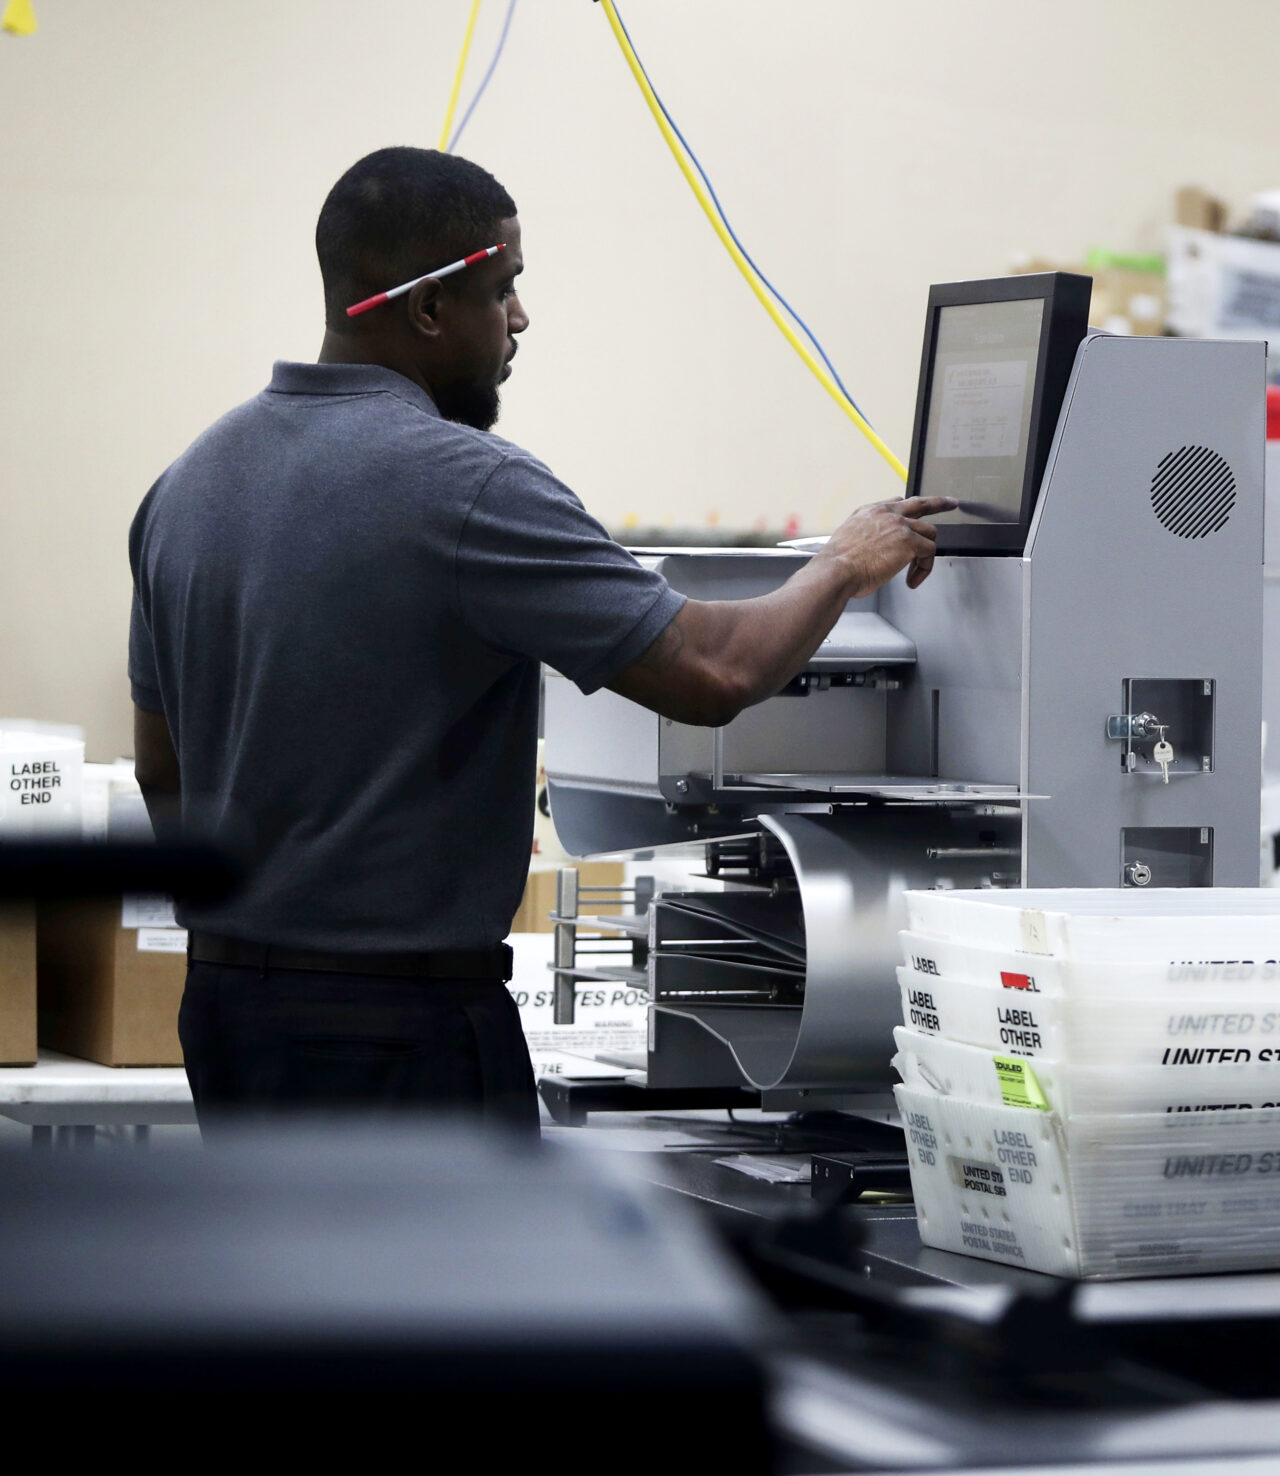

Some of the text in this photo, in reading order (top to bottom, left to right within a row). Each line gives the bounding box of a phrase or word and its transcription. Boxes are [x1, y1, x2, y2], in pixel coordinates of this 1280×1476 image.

[12, 761, 61, 775] LABEL
[10, 776, 62, 791] OTHER
[21, 792, 52, 805] END
[911, 954, 942, 977] LABEL
[908, 987, 937, 1011] LABEL
[910, 1008, 940, 1032] OTHER
[997, 1006, 1039, 1028] LABEL
[1168, 1013, 1255, 1036] UNITED
[1000, 1027, 1042, 1049] OTHER
[906, 1112, 934, 1132] LABEL
[993, 1129, 1034, 1149] LABEL
[918, 1148, 936, 1166] END
[998, 1148, 1038, 1167] OTHER
[1163, 1153, 1253, 1179] UNITED
[962, 1165, 991, 1181] UNITED
[1008, 1167, 1033, 1184] END
[964, 1179, 994, 1194] POSTAL
[961, 1220, 989, 1238] UNITED
